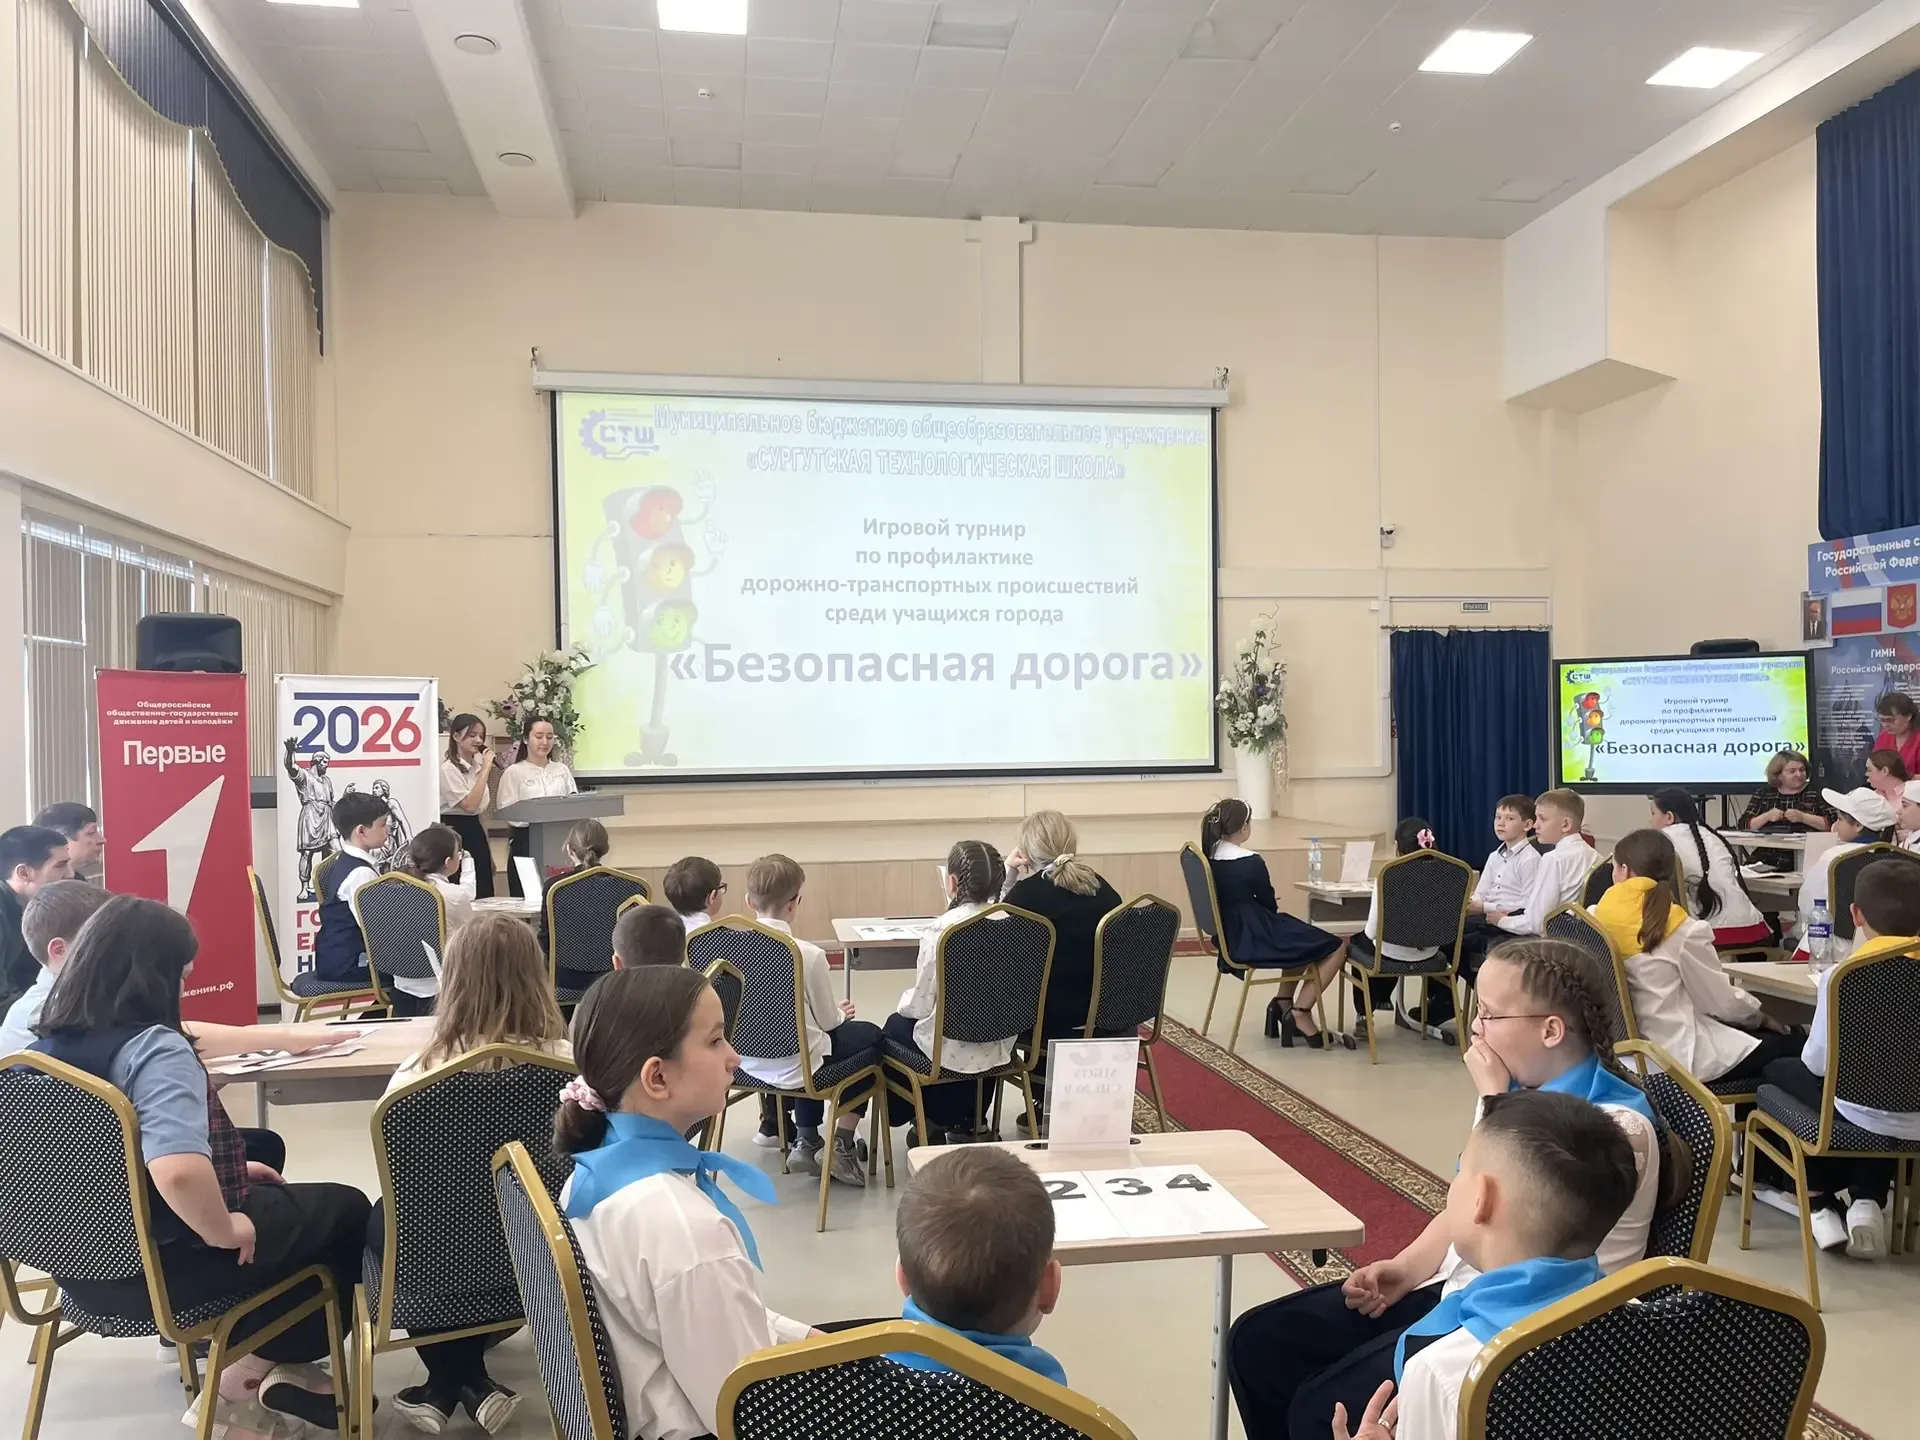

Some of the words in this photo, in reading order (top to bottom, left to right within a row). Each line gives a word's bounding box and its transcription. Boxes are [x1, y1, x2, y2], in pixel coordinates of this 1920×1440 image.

[600, 424, 655, 444] СТШ
[654, 404, 802, 434] Муниципальное
[806, 409, 908, 439] бюджетное
[911, 414, 1101, 445] общеобразовательное
[1104, 424, 1205, 449] учреждение
[746, 446, 872, 474] «СУРГУТСКАЯ
[876, 449, 1051, 478] ТЕХНОЛОГИЧЕСКАЯ
[1055, 454, 1127, 480] ШКОЛА»
[863, 518, 949, 538] Игровой
[956, 522, 1026, 541] турнир
[855, 549, 881, 564] по
[887, 547, 1033, 568] профилактике
[1817, 540, 1911, 562] Государственные
[1825, 559, 1887, 578] Российской
[1888, 556, 1920, 568] Феде
[740, 577, 992, 596] дорожно-транспортных
[997, 577, 1139, 597] происшествий
[825, 607, 887, 625] среди
[892, 607, 989, 625] учащихся
[996, 608, 1064, 626] города
[1870, 648, 1896, 658] ГИМН
[669, 643, 995, 683] «Безопасная
[1010, 652, 1202, 691] дорога»
[1831, 664, 1882, 675] Российской
[1664, 698, 1698, 706] Игровой
[1700, 698, 1729, 706] турнир
[106, 709, 239, 717] общественно-государственное
[159, 718, 184, 726] детей
[192, 718, 233, 726] молодёжи
[1717, 715, 1777, 725] происшествий
[293, 705, 421, 754] 2026
[1716, 727, 1745, 735] города
[123, 740, 226, 772] Первые
[1595, 741, 1717, 755] «Безопасная
[1723, 739, 1805, 755] дорога»
[296, 909, 322, 928] ГО
[182, 980, 234, 998] жении.рф
[1045, 1180, 1087, 1200] 2
[1105, 1177, 1153, 1196] 3
[1165, 1173, 1213, 1192] 4
